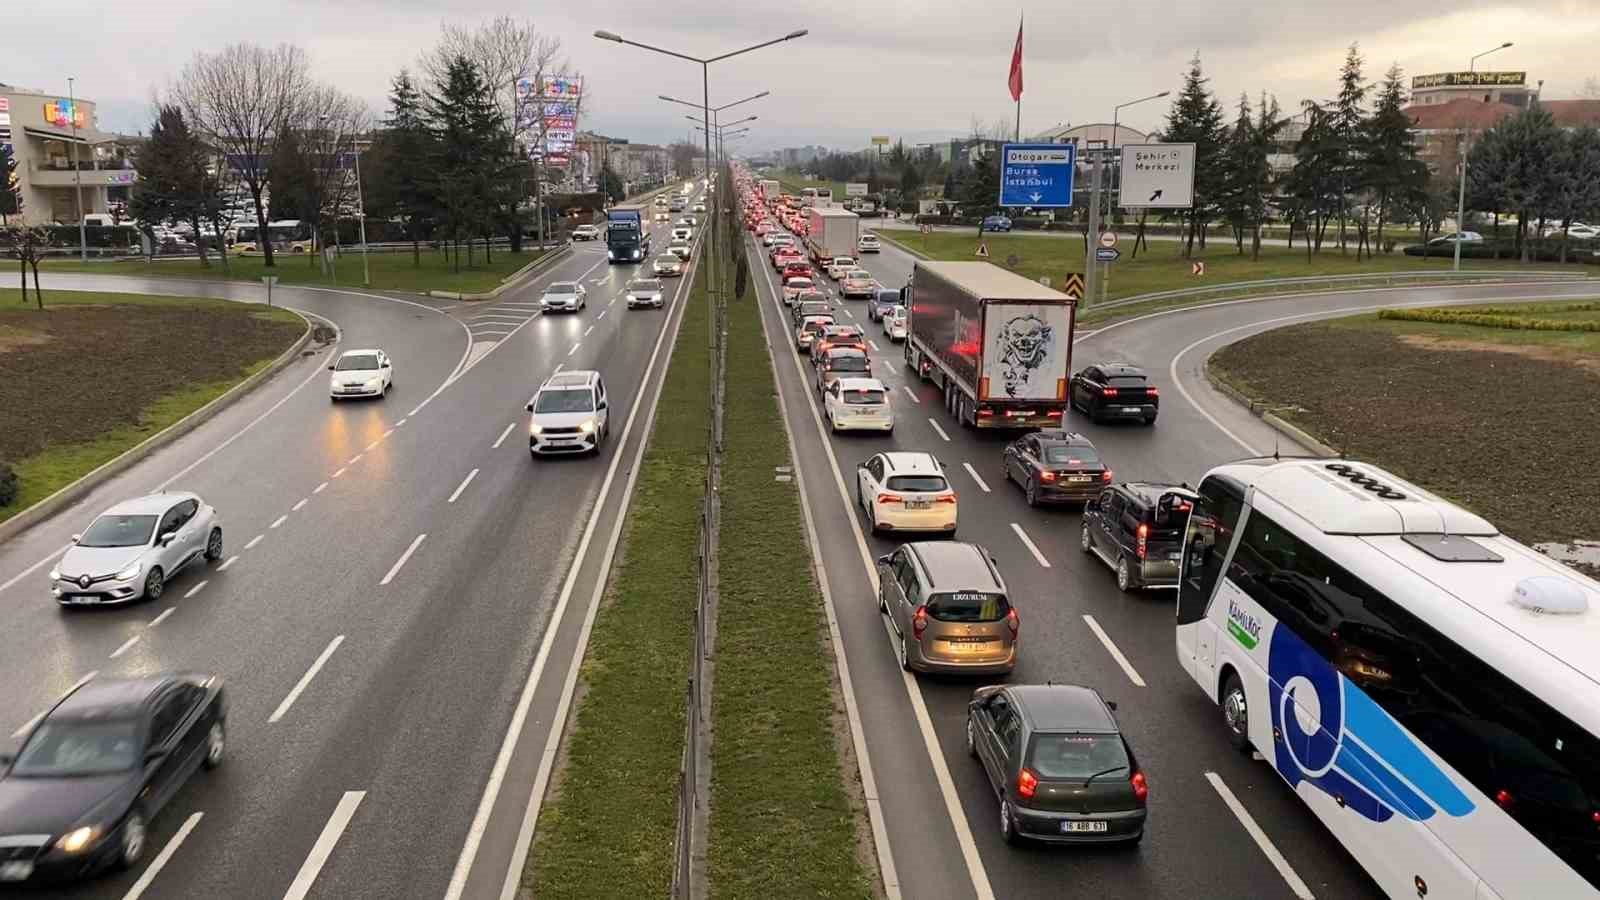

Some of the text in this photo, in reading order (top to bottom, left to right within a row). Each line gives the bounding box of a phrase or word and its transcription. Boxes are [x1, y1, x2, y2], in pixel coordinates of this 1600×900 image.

[1010, 153, 1047, 162] Otogar
[1136, 152, 1168, 161] Şehir
[1006, 167, 1038, 176] Bursa
[1135, 163, 1180, 171] Merkezi
[1006, 177, 1053, 186] İstanbul
